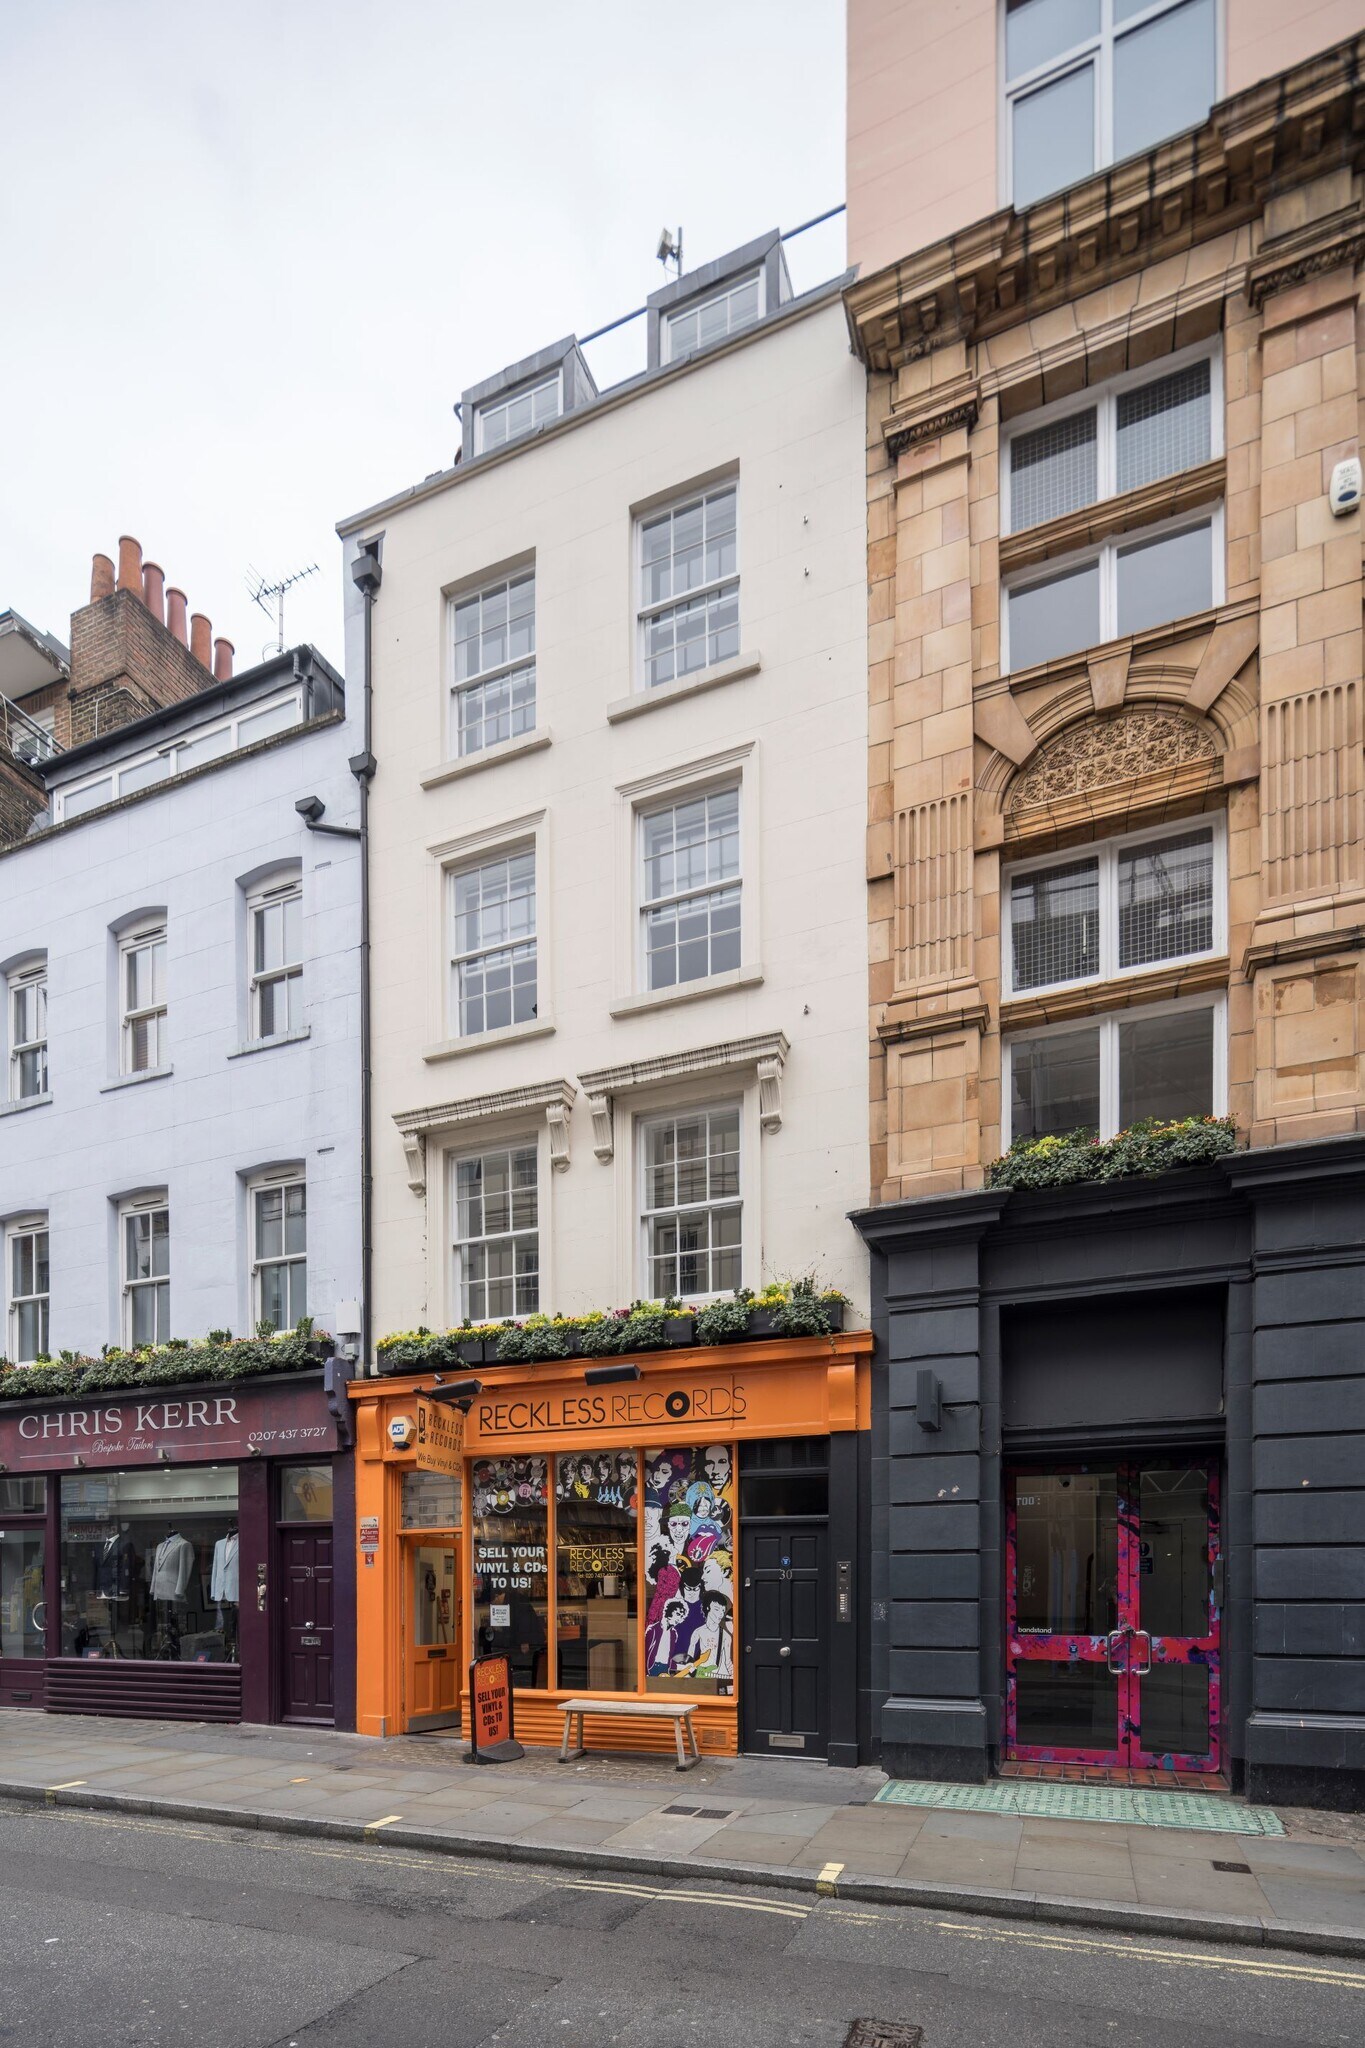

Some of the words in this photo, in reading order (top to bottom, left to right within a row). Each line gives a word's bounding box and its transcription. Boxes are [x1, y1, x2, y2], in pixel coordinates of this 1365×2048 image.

[479, 1396, 606, 1431] RECKLESS
[611, 1386, 747, 1422] RECORDS
[18, 1407, 123, 1440] CHRIS
[134, 1398, 241, 1433] KERR
[428, 1413, 464, 1436] RECKLESS
[248, 1430, 277, 1442] 0207
[278, 1428, 298, 1441] 437
[299, 1426, 327, 1439] 3727
[392, 1424, 404, 1435] ADT
[91, 1438, 125, 1456] Bespoke
[126, 1436, 154, 1451] Tailors
[429, 1431, 462, 1452] RECORDS
[417, 1451, 426, 1463] We
[426, 1454, 436, 1467] Buy
[448, 1460, 452, 1470] &
[478, 1547, 508, 1558] SELL
[511, 1546, 545, 1558] YOUR
[570, 1547, 625, 1560] RECKLESS
[305, 1566, 314, 1578] 31
[475, 1562, 509, 1573] VINYL
[512, 1562, 520, 1573] &
[523, 1561, 548, 1573] CDs
[570, 1559, 625, 1572] RECORDS
[779, 1569, 793, 1580] 30
[490, 1577, 507, 1588] TO
[510, 1577, 532, 1588] US!
[1017, 1626, 1052, 1634] bandstand
[476, 1663, 506, 1677] RECKLESS
[477, 1690, 491, 1703] SELL
[491, 1687, 506, 1699] YOUR
[481, 1702, 498, 1714] VINYL
[498, 1700, 503, 1710] &
[482, 1715, 495, 1727] CDs
[495, 1711, 503, 1723] TO
[488, 1725, 498, 1737] US!
